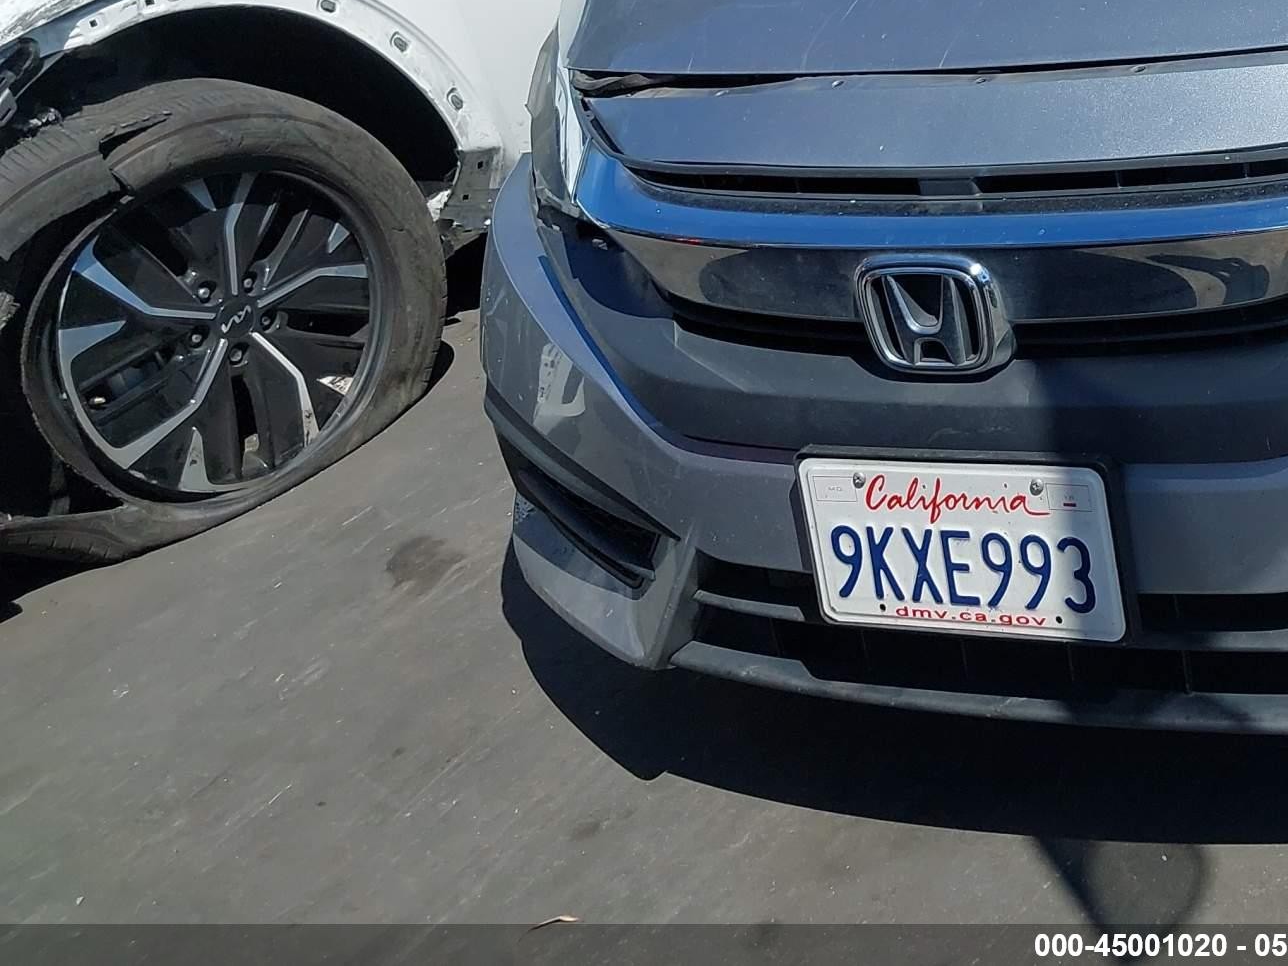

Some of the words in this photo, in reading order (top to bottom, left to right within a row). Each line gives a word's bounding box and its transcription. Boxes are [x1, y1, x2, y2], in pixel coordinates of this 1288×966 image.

[865, 474, 1051, 524] California
[830, 525, 1097, 614] 9KXE993
[895, 607, 1047, 629] dmv.ca.gov
